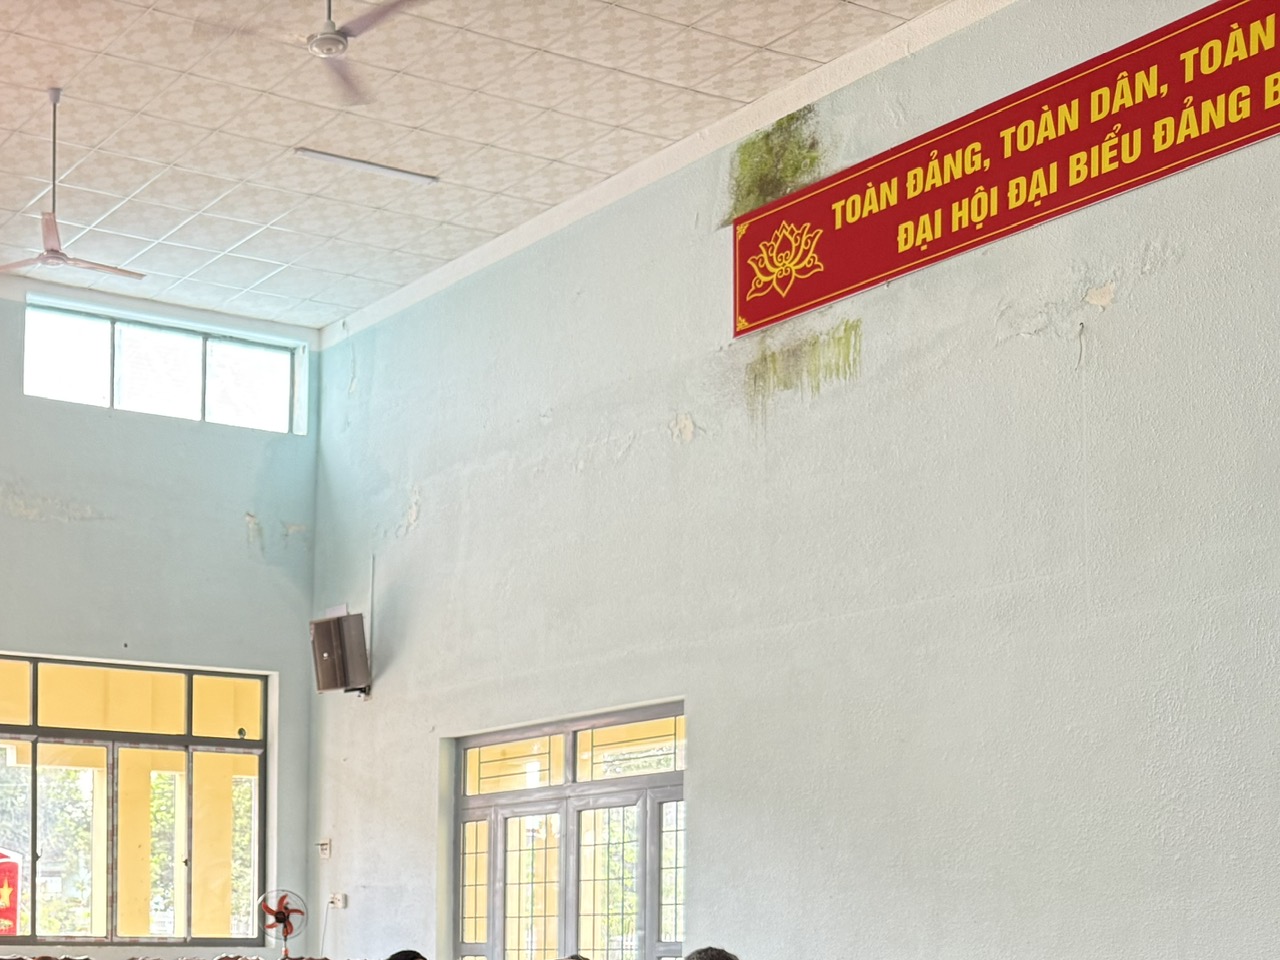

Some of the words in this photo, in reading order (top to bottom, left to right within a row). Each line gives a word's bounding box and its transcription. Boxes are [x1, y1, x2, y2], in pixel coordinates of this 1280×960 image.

[830, 176, 899, 230] TOÀN
[906, 141, 990, 200] ĐẢNG,
[1000, 105, 1079, 160] TOÀN
[1090, 64, 1169, 123] DÂN,
[1179, 13, 1276, 84] TOÀN
[897, 213, 943, 255] ĐẠI
[952, 184, 998, 231] HỘI
[1007, 165, 1058, 211] ĐẠI
[1068, 124, 1141, 186] BIỂU
[1152, 84, 1251, 153] ĐẢNG
